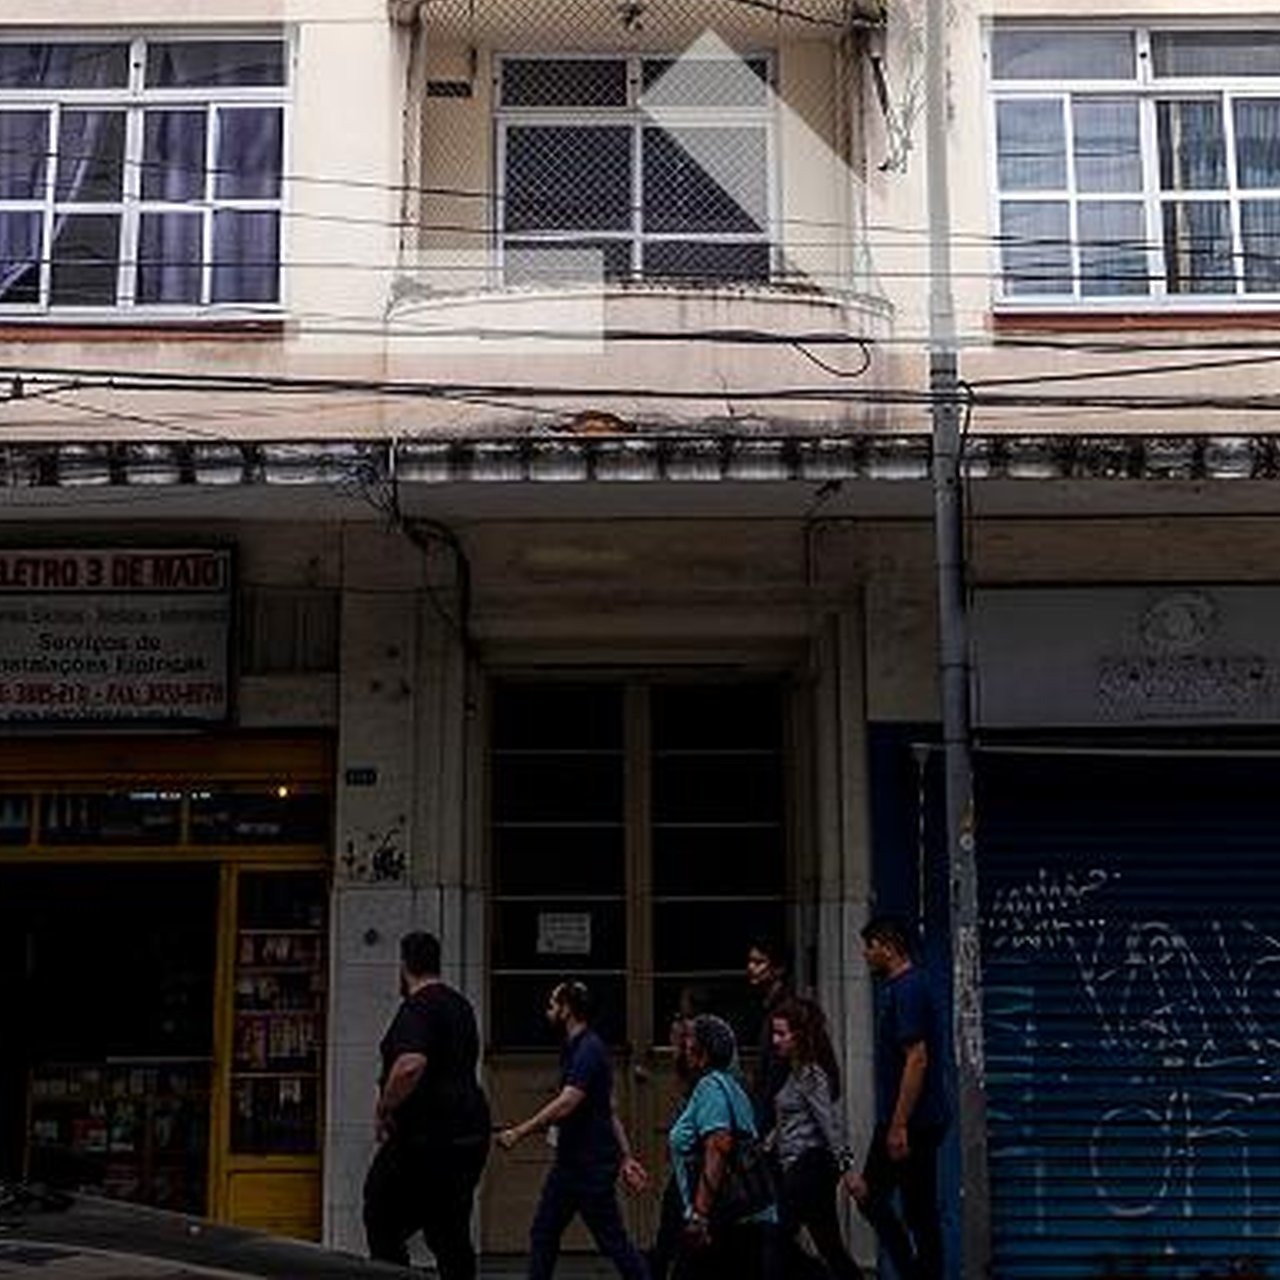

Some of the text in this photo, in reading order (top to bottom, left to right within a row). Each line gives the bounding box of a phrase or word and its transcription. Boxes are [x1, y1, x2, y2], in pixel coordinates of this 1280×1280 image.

[86, 559, 103, 586] 3
[112, 557, 144, 587] DE
[153, 557, 219, 587] MAIO
